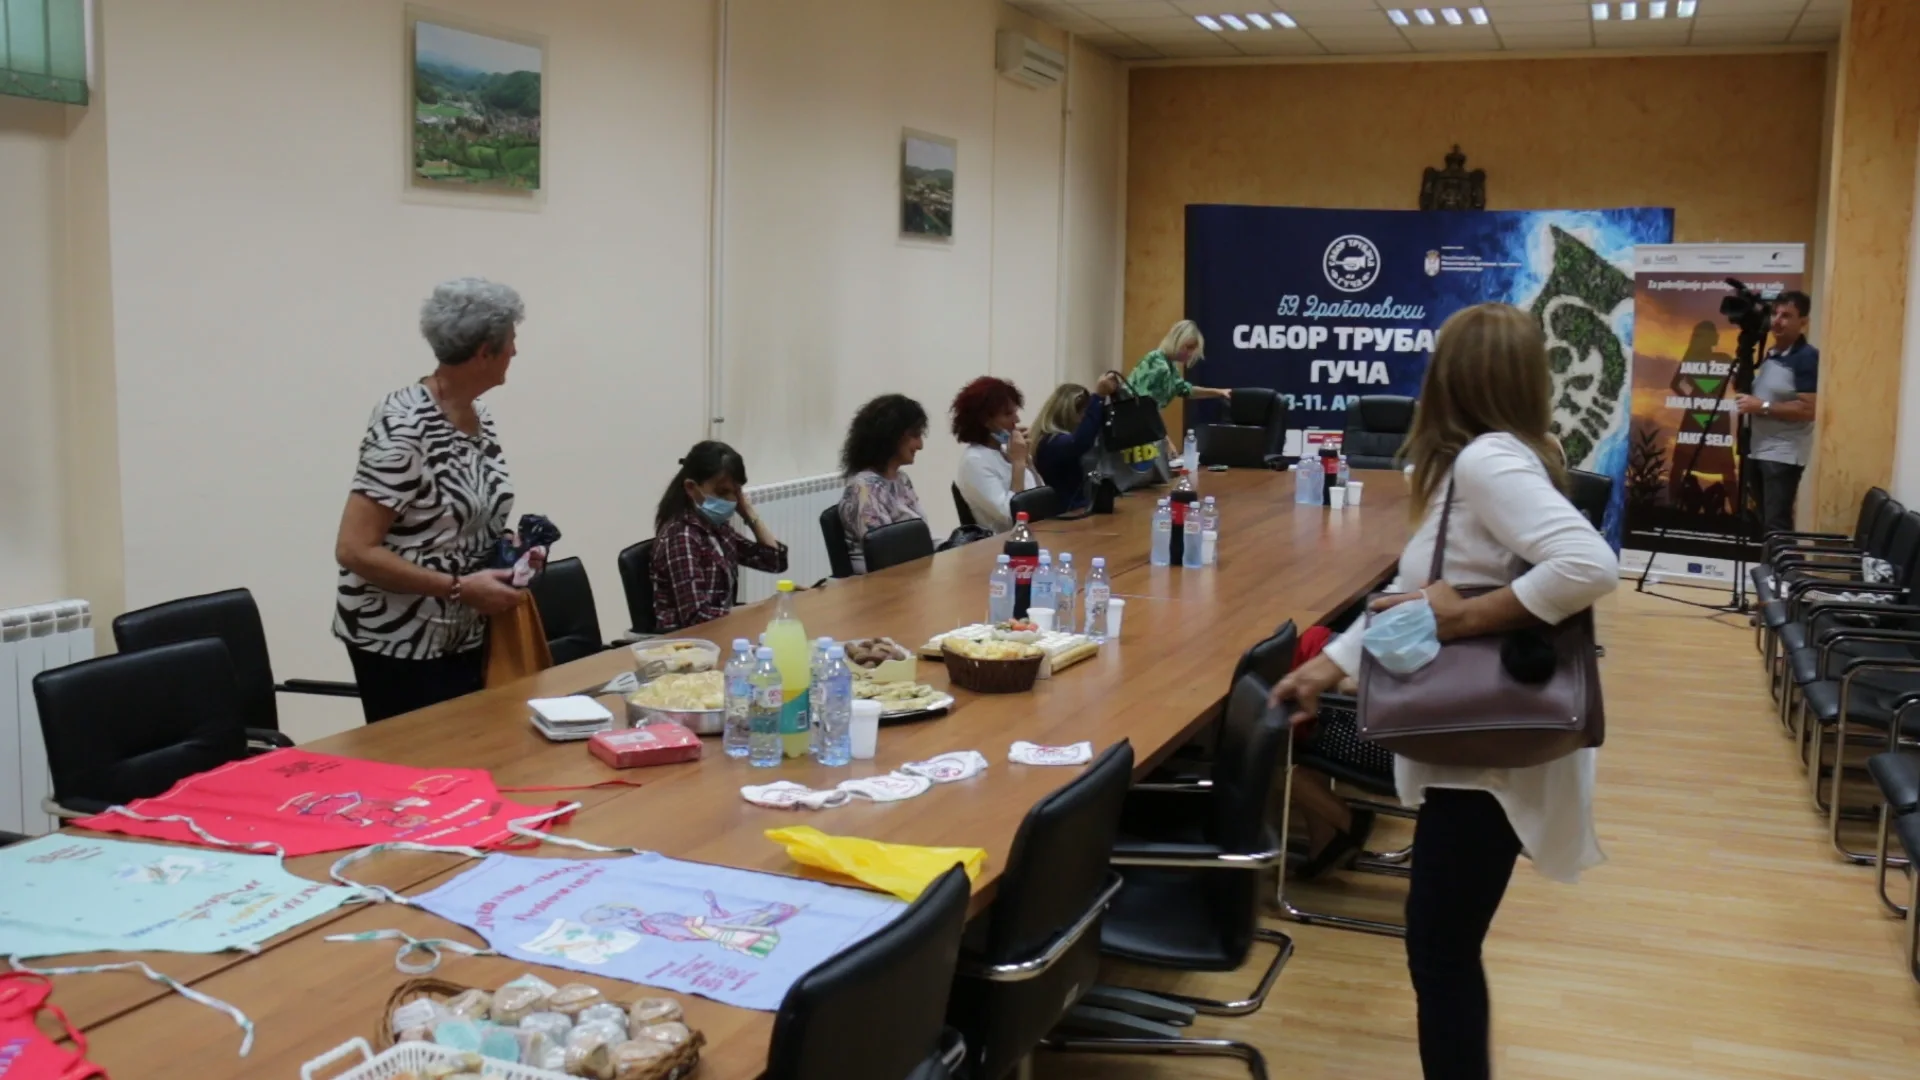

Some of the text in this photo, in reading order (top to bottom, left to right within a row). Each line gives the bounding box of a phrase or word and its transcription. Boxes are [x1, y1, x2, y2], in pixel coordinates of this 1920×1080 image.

[1277, 295, 1300, 316] 59.
[1233, 325, 1440, 353] САБОР ТРУБА
[1310, 359, 1390, 385] ГУЧА
[1680, 361, 1708, 375] JAKA
[1665, 396, 1692, 410] JAKA
[1704, 433, 1734, 448] SELO
